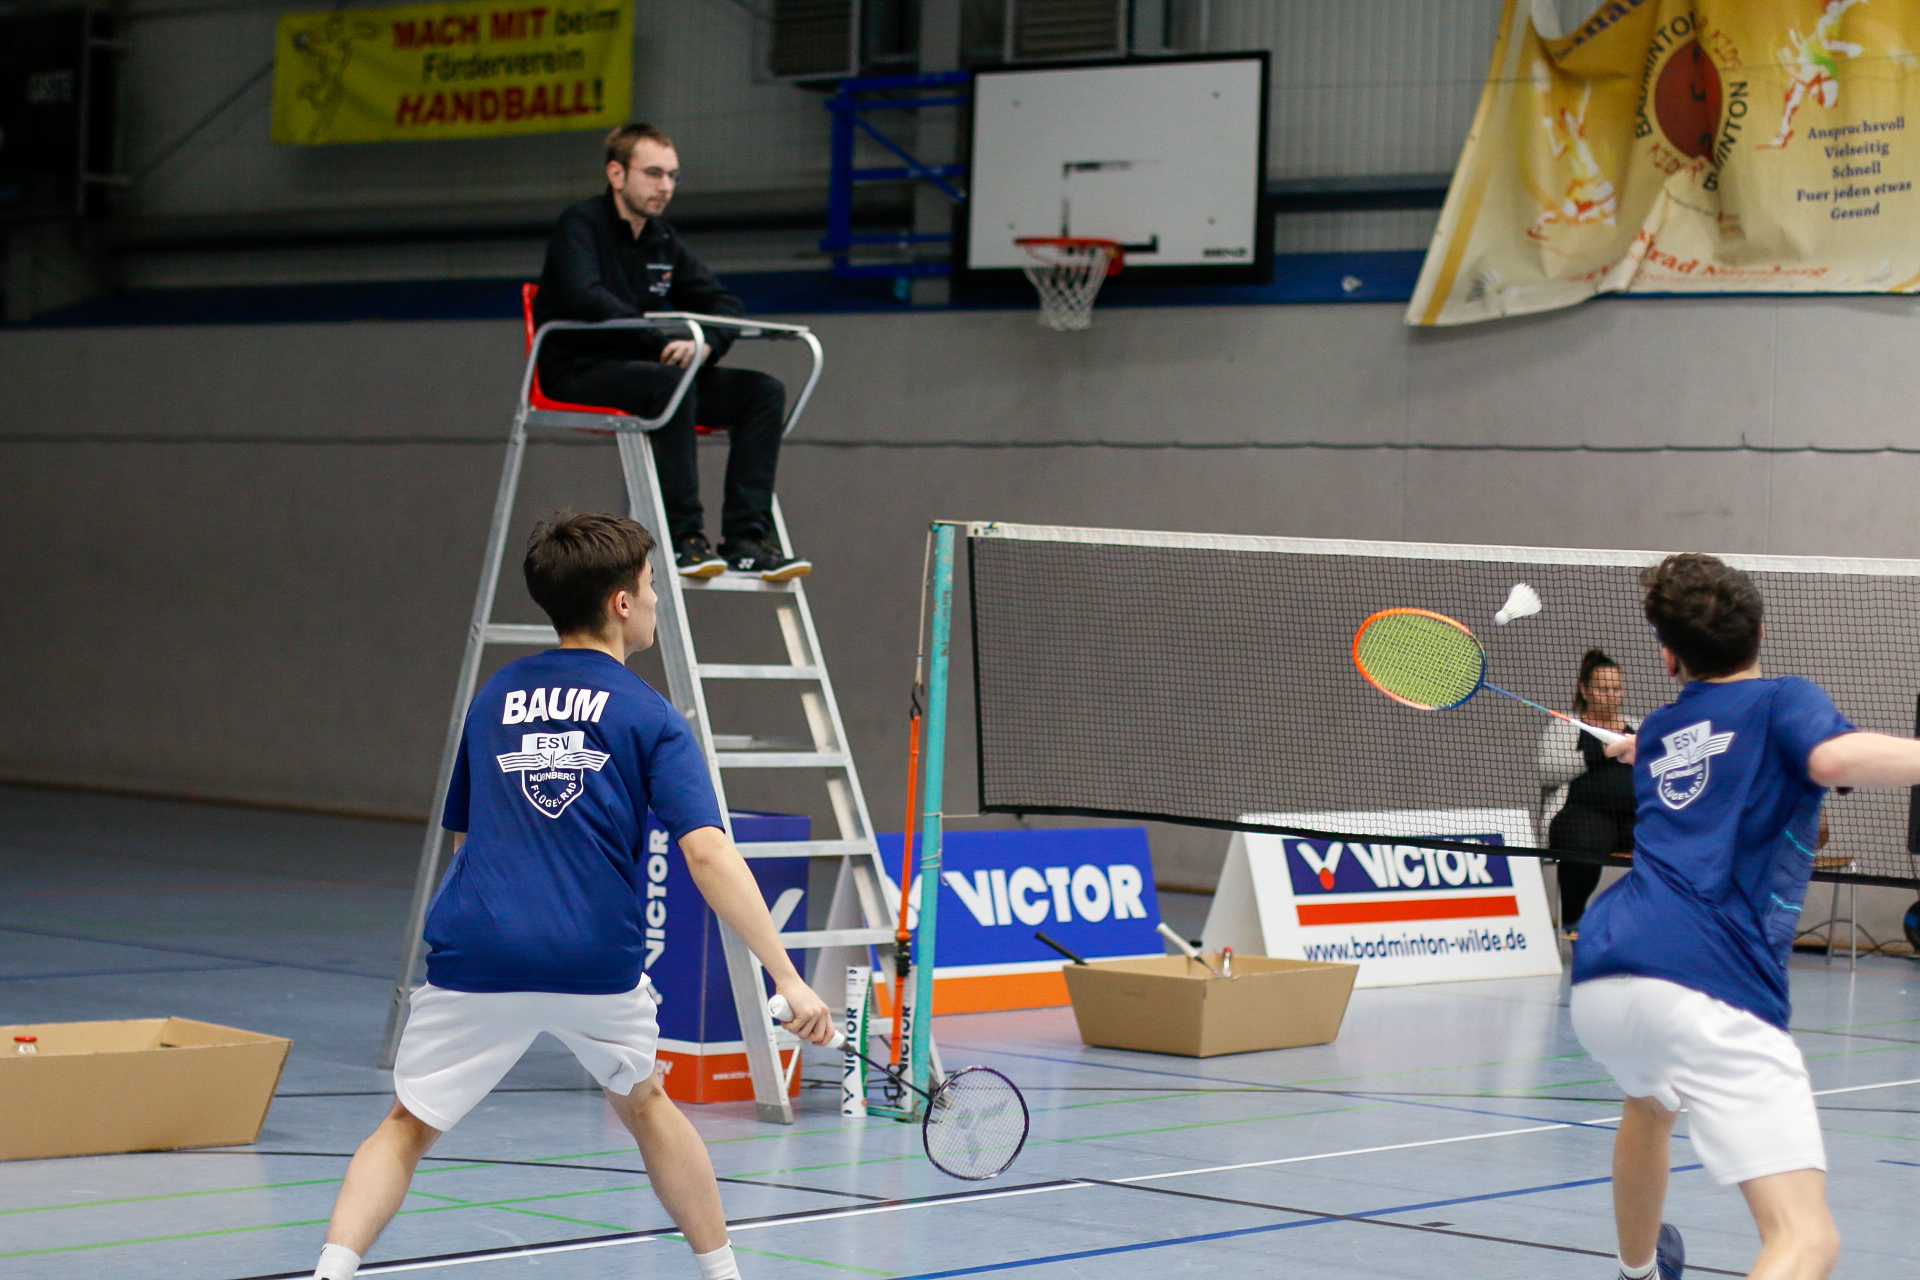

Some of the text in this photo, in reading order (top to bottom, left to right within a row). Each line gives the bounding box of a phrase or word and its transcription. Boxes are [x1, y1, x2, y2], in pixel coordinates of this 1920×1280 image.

[392, 6, 620, 50] MACH MIT beim
[395, 78, 604, 127] HANDBALL!
[1808, 116, 1905, 141] Anspruchsvoll
[1824, 140, 1889, 158] Vielseitig
[1832, 161, 1881, 178] Schnell
[1797, 181, 1912, 202] Fuer jeden etwas
[1831, 202, 1880, 220] Gesund
[501, 687, 610, 725] BAUM
[536, 736, 570, 750] ESV
[1673, 728, 1699, 750] ESV
[1346, 839, 1494, 888] VICTOR
[644, 829, 669, 971] VICTOR
[943, 864, 1147, 927] VICTOR
[1303, 928, 1527, 961] www.badminton-wilde.de
